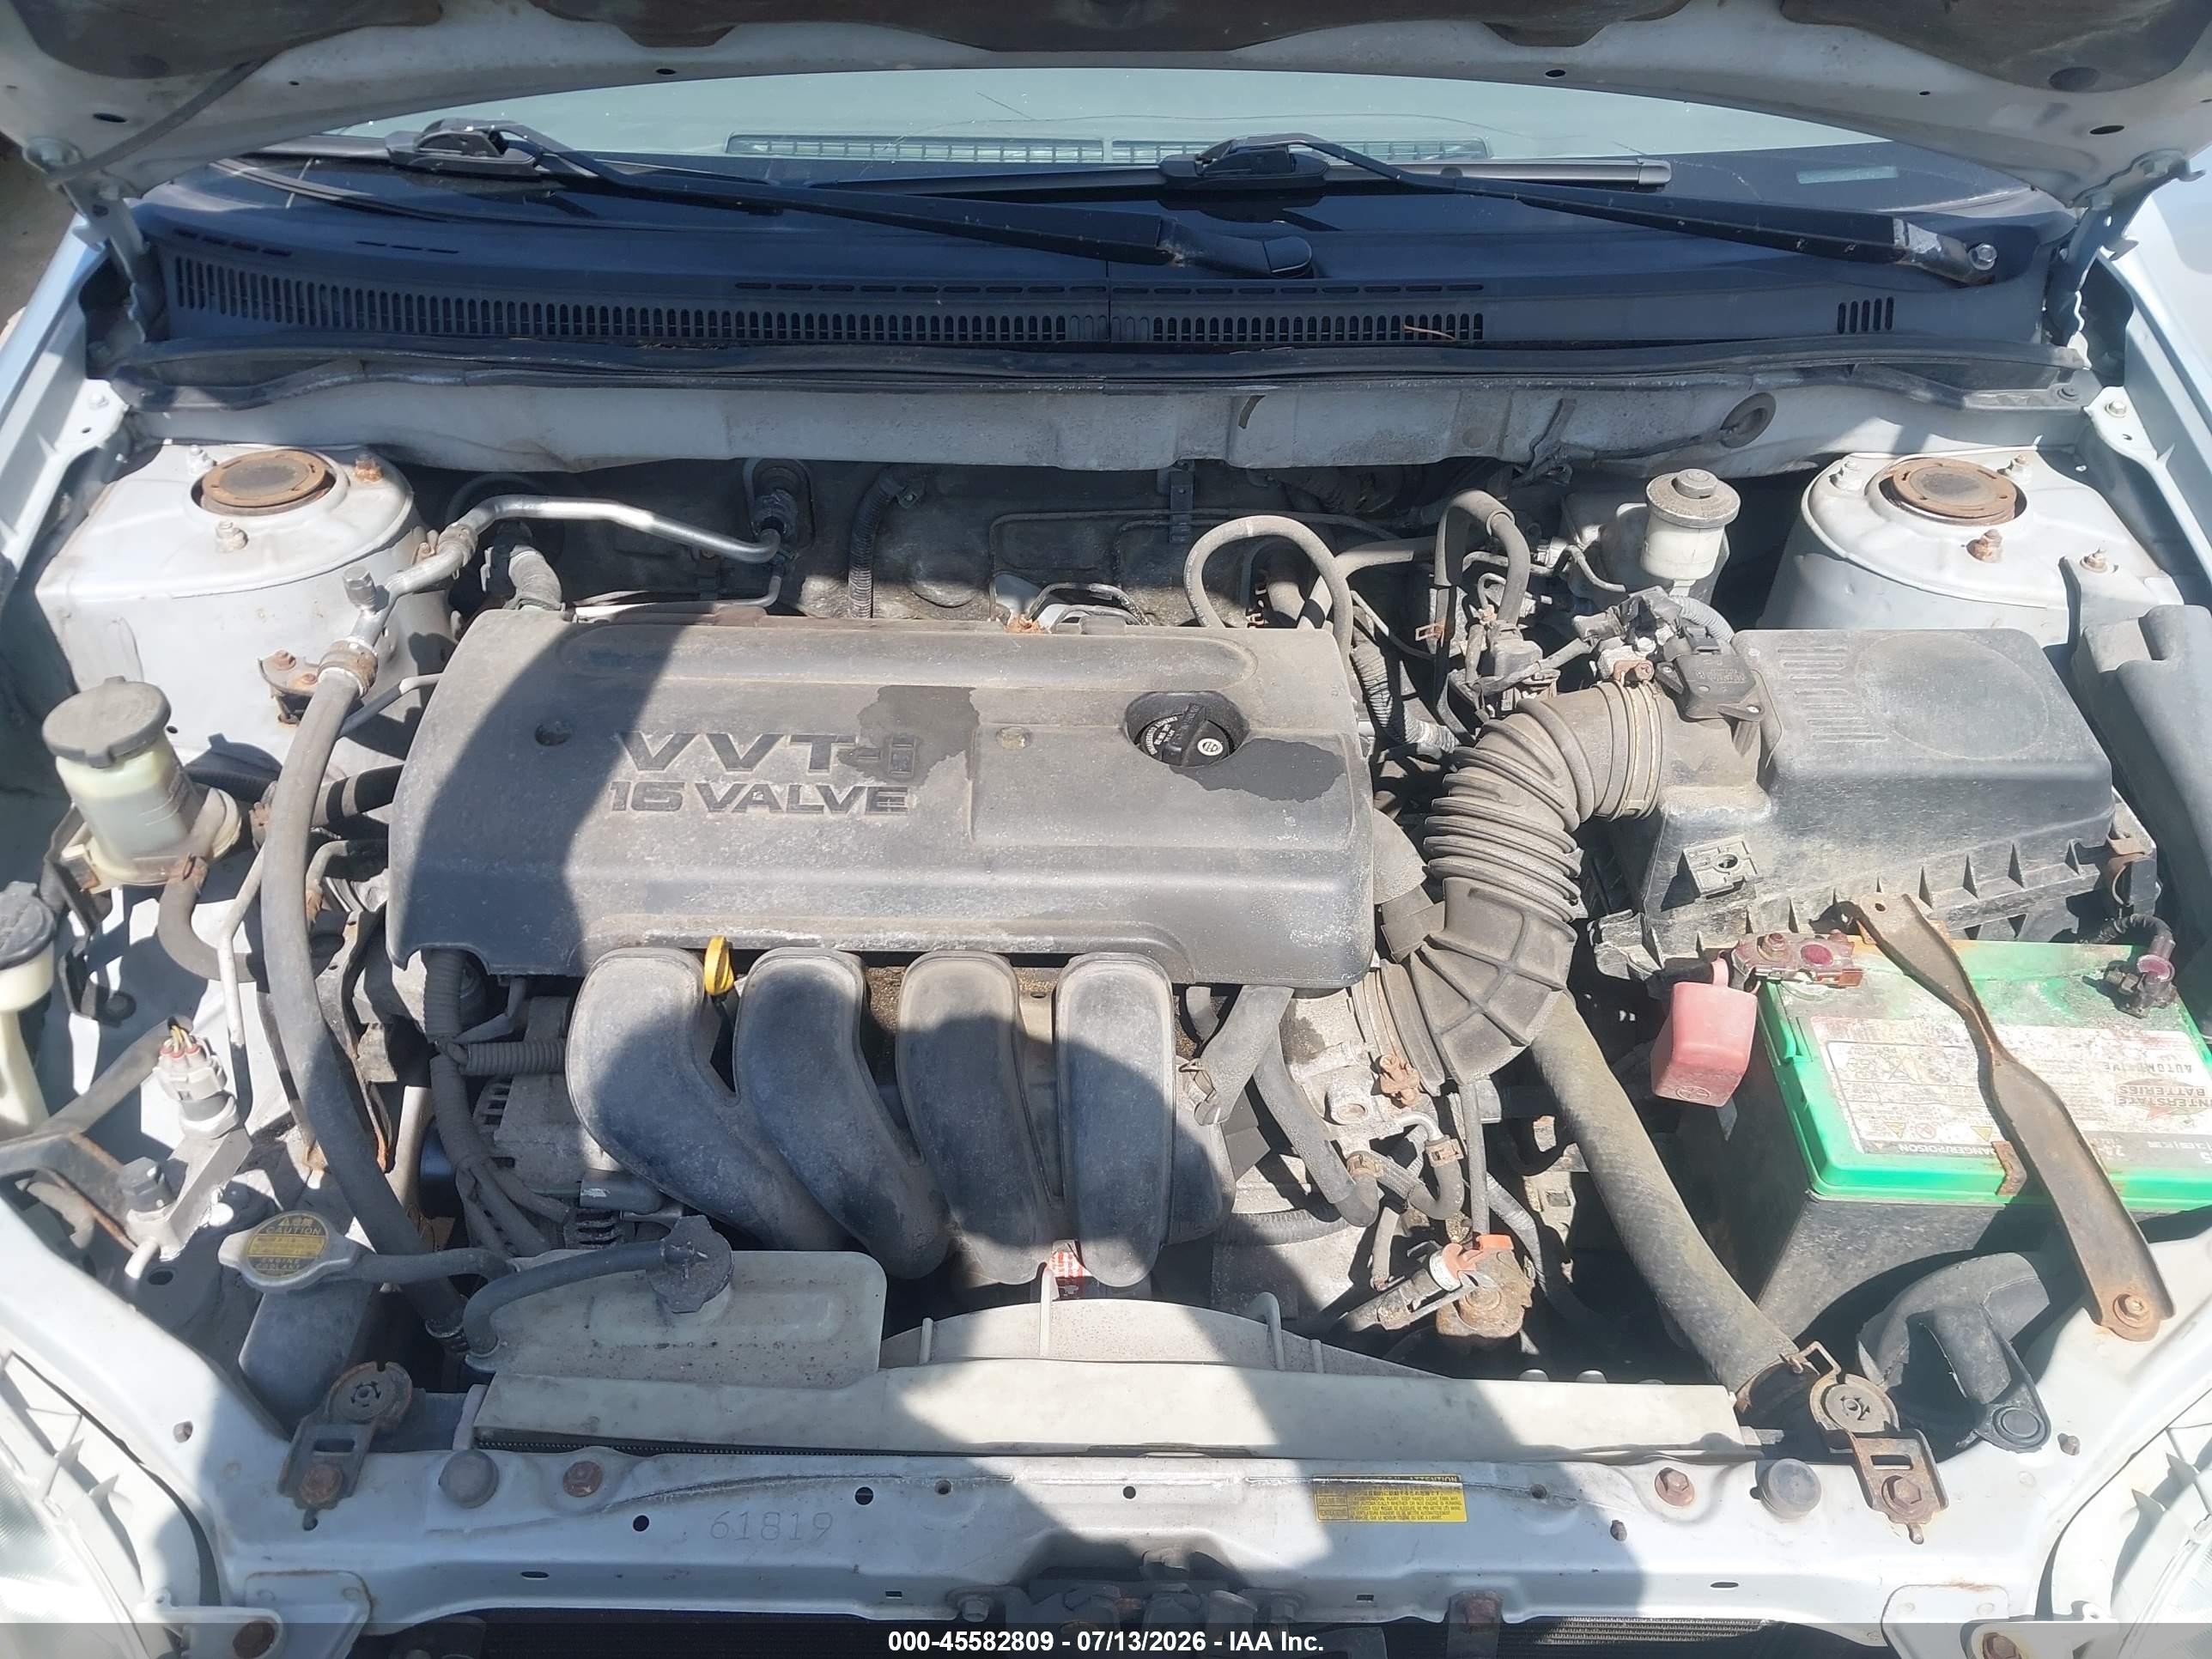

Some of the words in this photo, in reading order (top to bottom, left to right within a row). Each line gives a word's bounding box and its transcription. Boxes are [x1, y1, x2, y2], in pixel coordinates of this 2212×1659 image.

[609, 781, 686, 812] 16
[696, 782, 909, 816] VALVE
[2103, 1063, 2192, 1073] AUTOMOIVE
[2118, 1085, 2206, 1097] BATTERIES
[2118, 1096, 2212, 1108] INTERSTATE
[266, 1226, 322, 1235] CAUTION
[709, 1510, 834, 1541] 61819
